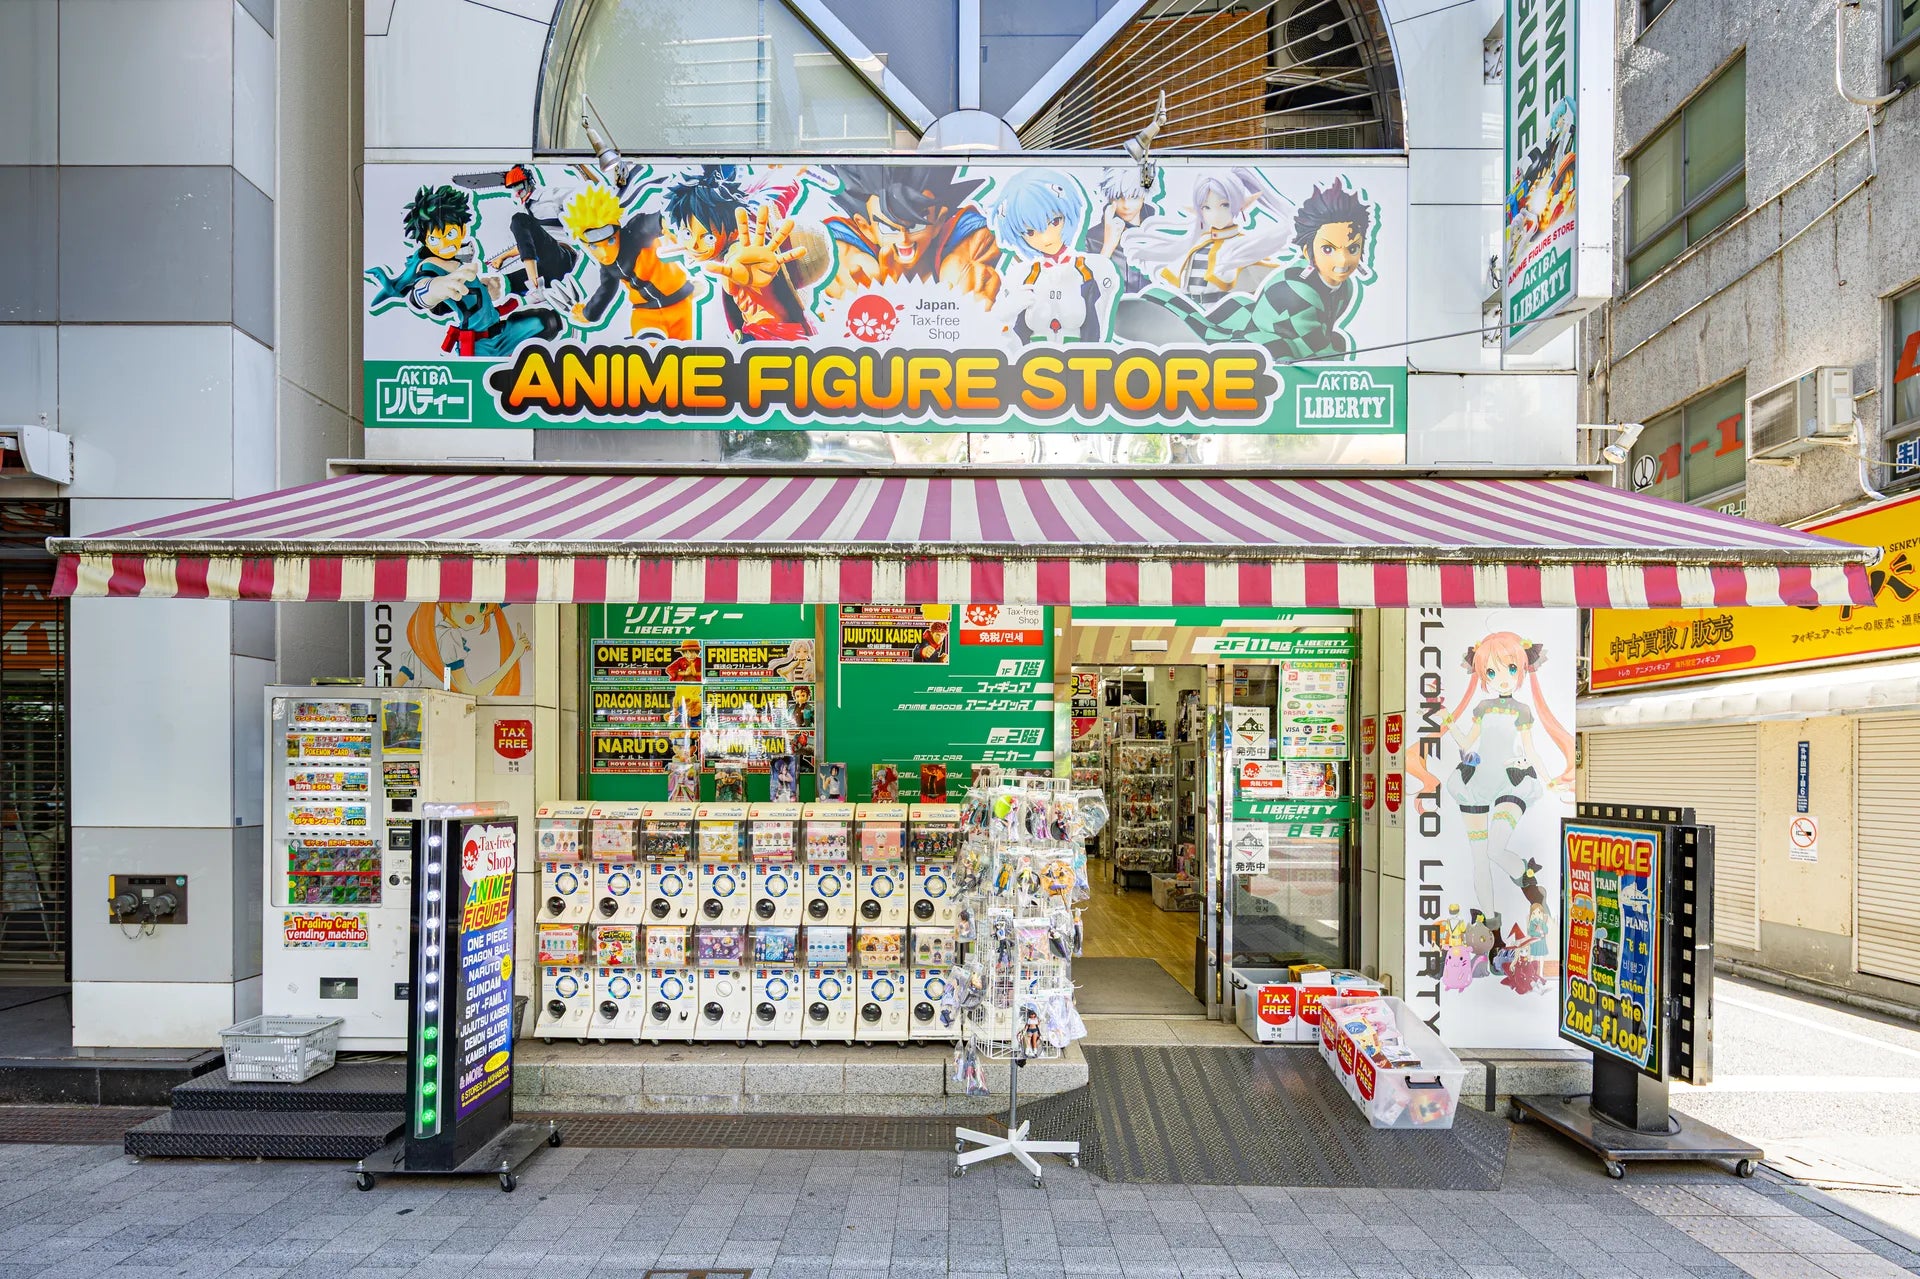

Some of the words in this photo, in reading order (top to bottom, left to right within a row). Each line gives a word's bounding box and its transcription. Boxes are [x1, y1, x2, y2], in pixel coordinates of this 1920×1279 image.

[1508, 258, 1527, 287] ANIME
[1528, 235, 1551, 263] FIGURE
[1553, 220, 1575, 241] STORE
[1523, 250, 1556, 290] AKIBA
[1513, 262, 1567, 328] LIBERTY
[916, 298, 959, 313] Japan.
[910, 314, 960, 328] Tax-free
[928, 328, 960, 342] Shop
[401, 371, 448, 385] AKIBA
[508, 353, 726, 409] ANIME
[748, 354, 1000, 410] FIGURE
[1021, 355, 1258, 412] STORE
[1320, 375, 1370, 391] AKIBA
[384, 386, 465, 415] リバティー
[1304, 396, 1386, 419] LIBERTY
[625, 606, 744, 625] リバティー
[1006, 607, 1039, 616] Tax-free
[1018, 616, 1039, 626] Shop
[623, 626, 696, 635] LIBERTY
[844, 628, 883, 644] JUJUTSU
[885, 628, 922, 644] KAISEN
[1295, 639, 1349, 647] LIBERTY
[597, 647, 628, 662] ONE
[632, 647, 672, 662] PIECE
[707, 647, 768, 663] FRIEREN
[1014, 661, 1040, 676] 1階
[1618, 669, 1630, 677] トレカ
[977, 681, 1032, 693] フィギュア
[595, 693, 642, 709] DRAGON
[644, 693, 671, 709] BALL
[501, 727, 525, 737] TAX
[1387, 723, 1400, 733] TAX
[498, 739, 528, 748] FREE
[1005, 729, 1041, 744] 2階
[1386, 733, 1401, 744] FREE
[333, 748, 349, 756] CARD
[598, 738, 669, 754] NARUTO
[1236, 746, 1266, 757] 発売中
[982, 750, 1031, 761] ミニカー
[1387, 781, 1399, 791] TAX
[1386, 792, 1400, 802] FREE
[1249, 804, 1337, 815] LIBERTY
[1417, 784, 1441, 838] TO
[480, 834, 512, 852] Tax-free
[487, 851, 512, 874] Shop
[1569, 838, 1650, 873] VEHICLE
[1235, 862, 1266, 871] 発売中
[1571, 868, 1591, 881] MINI
[467, 874, 512, 906] ANIME
[1572, 880, 1590, 893] CAR
[1595, 877, 1617, 891] TRAIN
[296, 918, 332, 929] Trading
[335, 918, 358, 929] Card
[461, 900, 508, 933] FIGURE
[1625, 915, 1649, 932] PLANE
[288, 930, 325, 940] vending
[328, 930, 365, 939] machine
[467, 935, 484, 952] ONE
[486, 927, 508, 946] PIECE
[462, 948, 493, 969] DRAGON
[494, 942, 510, 955] BALL
[1416, 860, 1444, 1036] LIBERTY
[1570, 953, 1586, 964] mini
[468, 960, 500, 983] NARUTO
[1568, 963, 1587, 976] coche
[1622, 960, 1646, 976] 비행기
[1592, 968, 1614, 987] tren
[466, 976, 501, 1002] GUNDAM
[1264, 994, 1290, 1004] TAX
[1572, 980, 1596, 1005] SOLD
[1601, 996, 1615, 1013] on
[1621, 999, 1642, 1021] the
[465, 1001, 480, 1019] SPY
[1262, 1005, 1292, 1015] FREE
[460, 1014, 489, 1038] JUJUTSU
[489, 1003, 510, 1022] KAISEN
[1323, 1012, 1335, 1032] TAX
[1567, 1001, 1593, 1035] 2nd
[1601, 1015, 1647, 1056] floor
[464, 1030, 485, 1052] DEMON
[486, 1018, 508, 1040] SLAYER
[465, 1044, 487, 1066] KAMEN
[488, 1034, 507, 1053] RIDER
[1340, 1033, 1353, 1057] TAX
[1338, 1045, 1353, 1070] FREE
[465, 1063, 484, 1087] MORE
[1358, 1056, 1373, 1081] TAX
[1356, 1068, 1373, 1094] FREE
[465, 1081, 483, 1099] STORES
